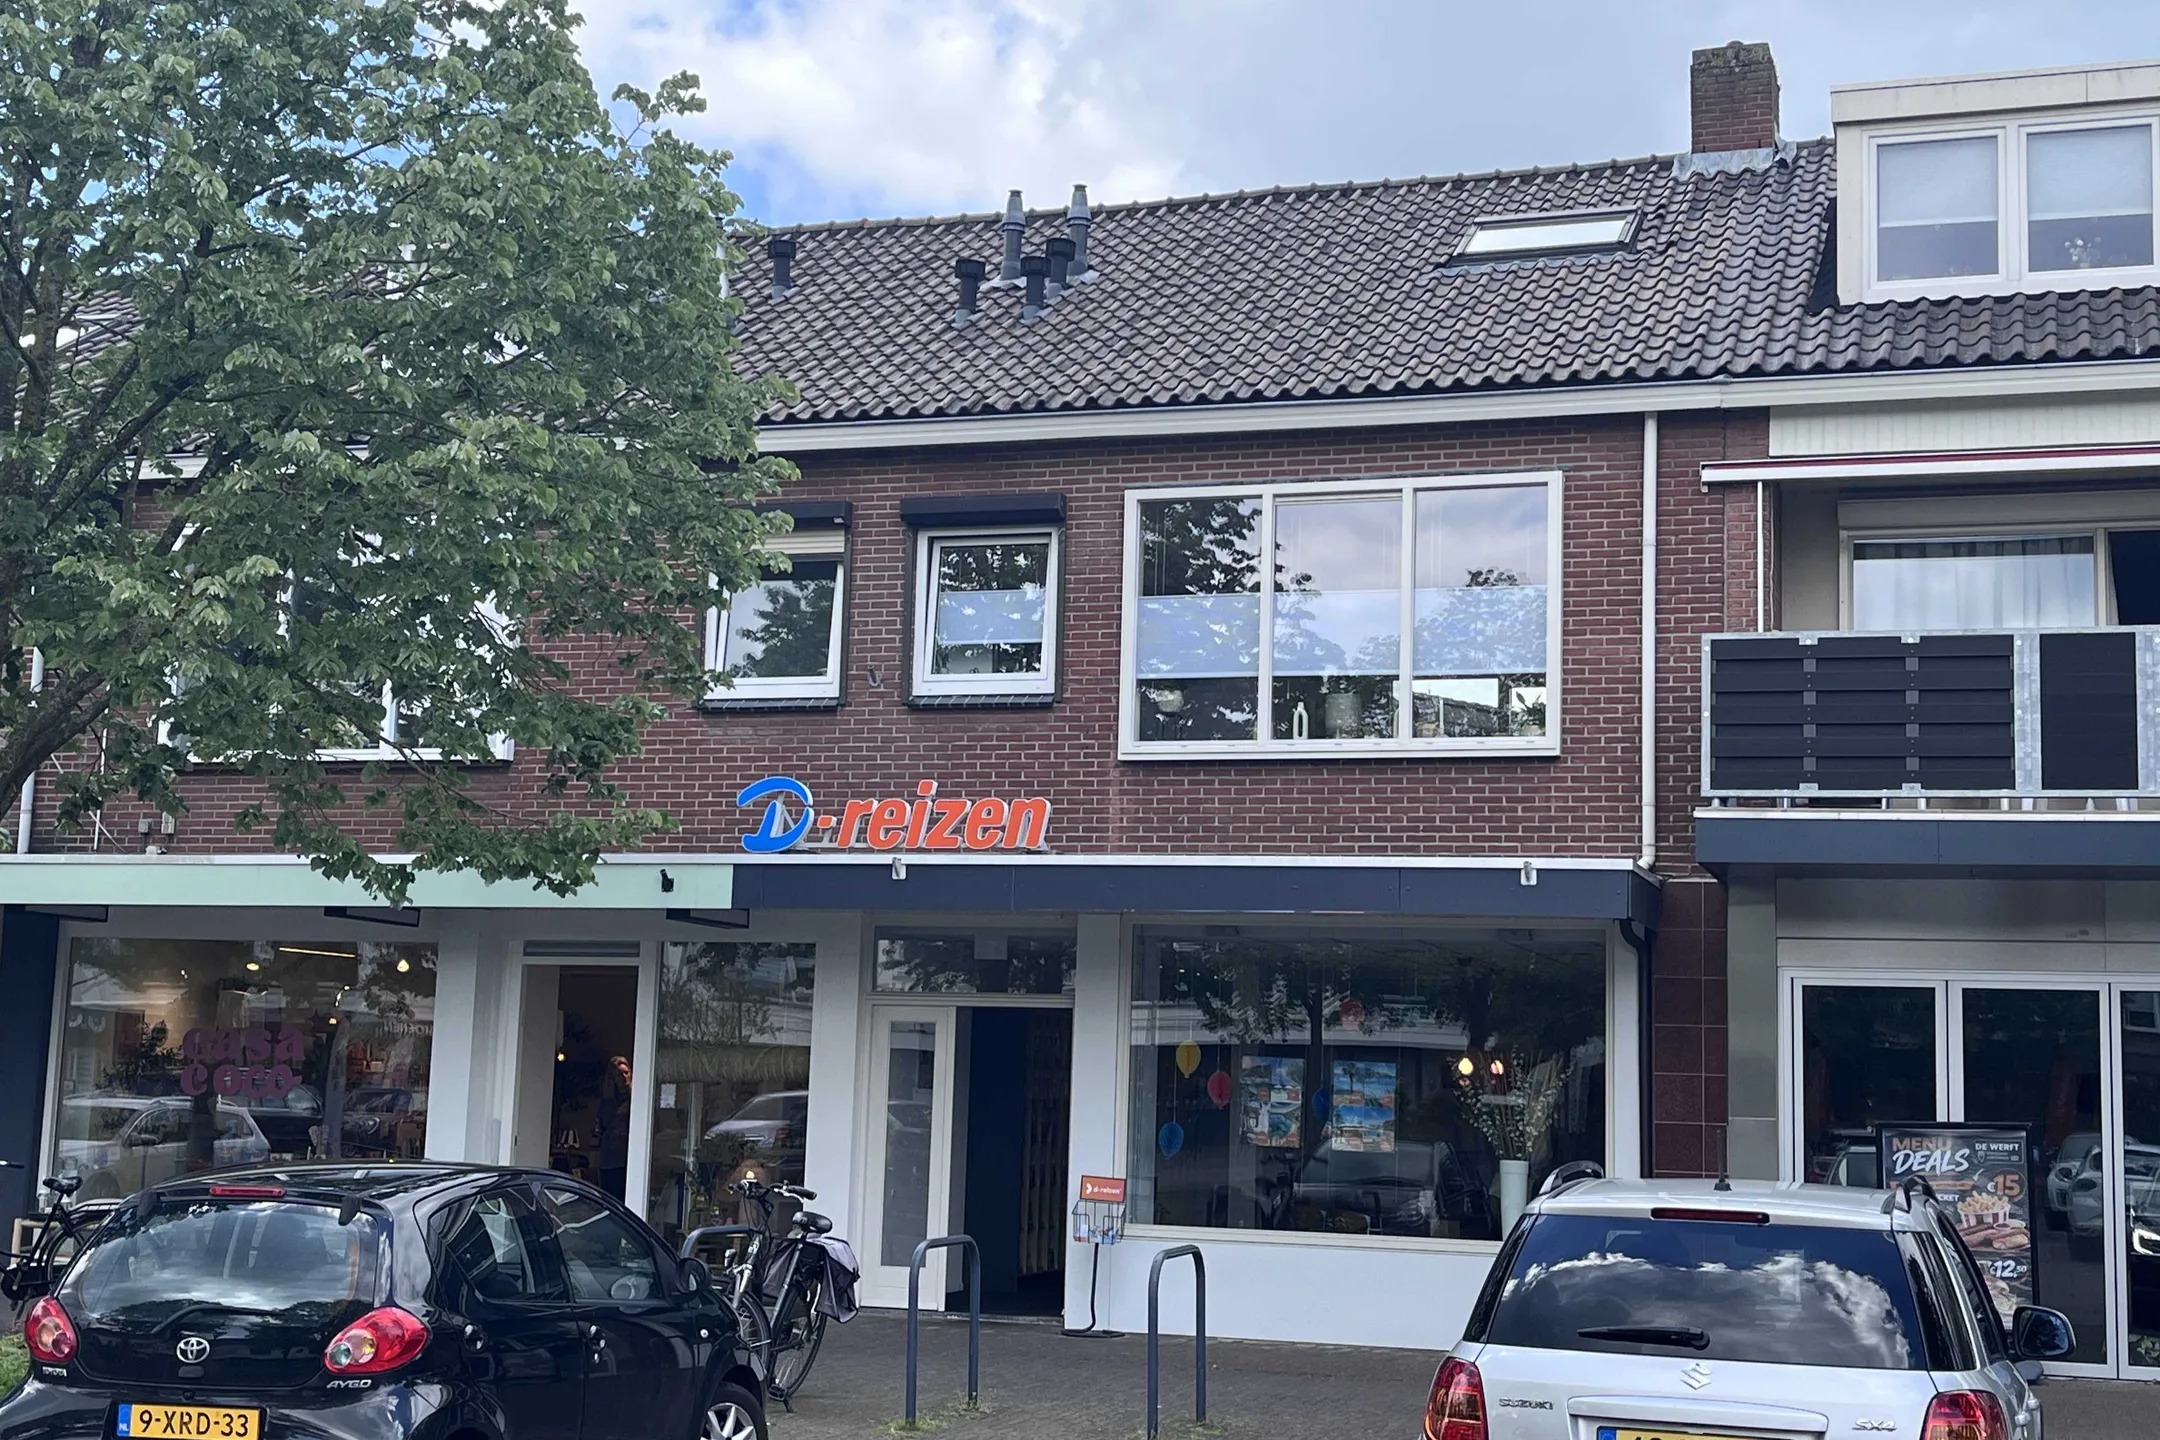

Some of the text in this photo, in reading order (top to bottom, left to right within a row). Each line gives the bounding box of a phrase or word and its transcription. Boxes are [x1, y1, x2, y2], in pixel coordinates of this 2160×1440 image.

[737, 776, 1052, 853] D-reizen
[1892, 1137, 1952, 1151] MENU
[1975, 1143, 2019, 1151] DE WERFT
[1892, 1149, 1970, 1176] DEALS
[1936, 1193, 1960, 1202] CKET
[326, 1379, 373, 1389] AYGO
[1499, 1397, 1554, 1410] SUZUKI
[118, 1409, 249, 1438] NL 9-XRD-33
[1852, 1418, 1897, 1432] SX4
